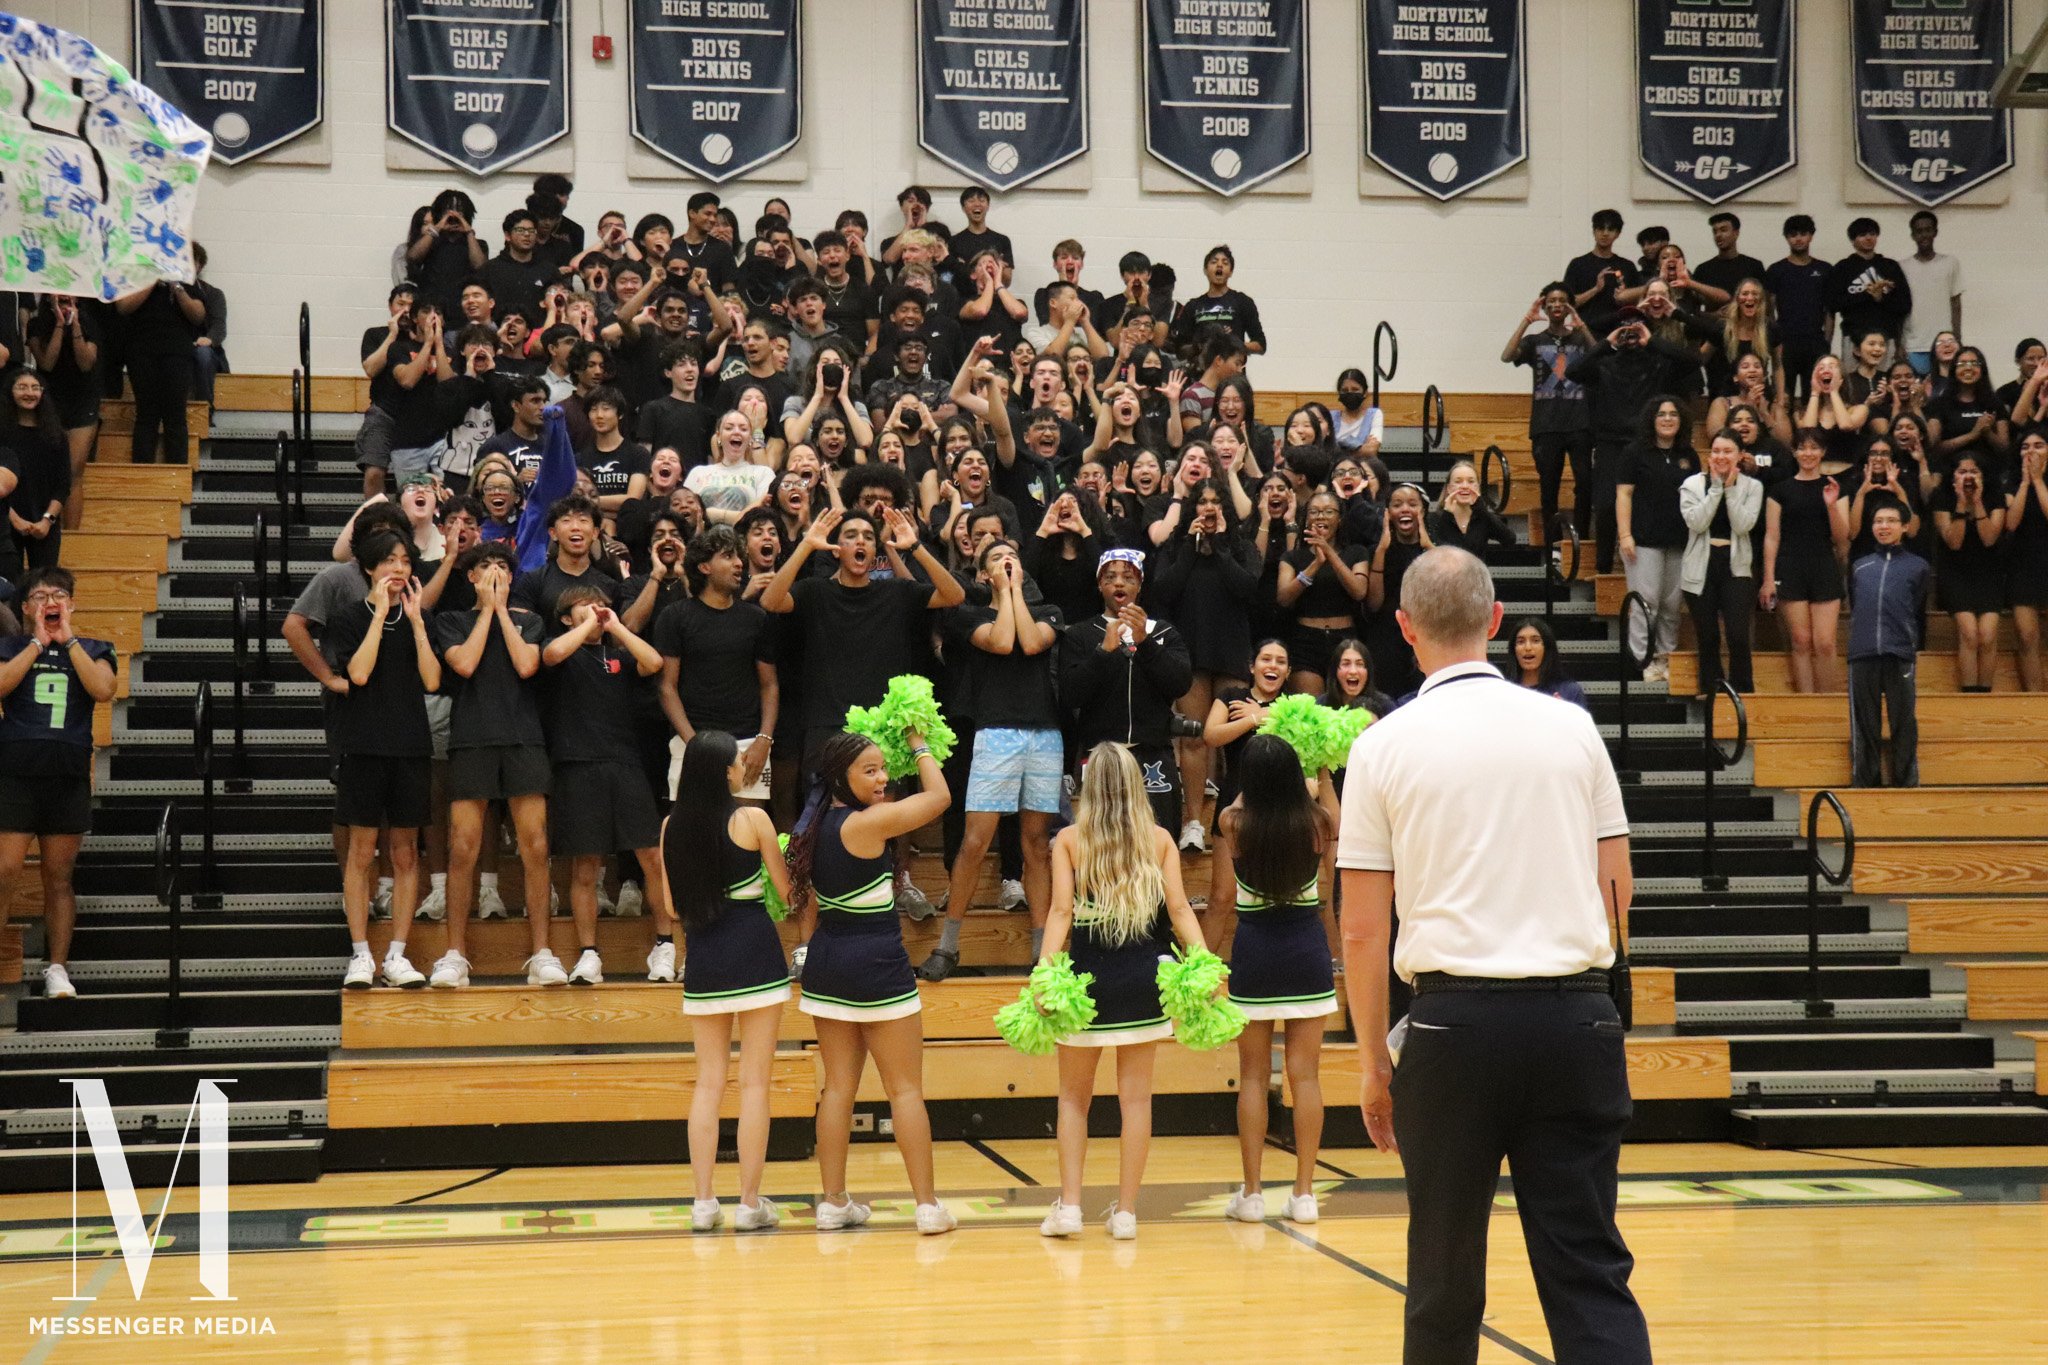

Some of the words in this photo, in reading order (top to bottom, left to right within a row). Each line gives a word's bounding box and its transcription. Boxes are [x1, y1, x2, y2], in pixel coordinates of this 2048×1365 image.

[662, 0, 701, 16] HIGH
[707, 2, 769, 19] SCHOOL
[955, 0, 1047, 10] NORTHVIEW
[1179, 0, 1270, 17] NORTHVIEW
[950, 11, 988, 27] HIGH
[994, 13, 1054, 30] SCHOOL
[1398, 6, 1487, 23] NORTHVIEW
[1670, 12, 1758, 28] NORTHVIEW
[1885, 15, 1973, 31] NORTHVIEW
[205, 15, 256, 35] BOYS
[1174, 18, 1212, 35] HIGH
[1217, 20, 1276, 36] SCHOOL
[1393, 24, 1429, 40] HIGH
[1435, 26, 1493, 42] SCHOOL
[204, 37, 257, 57] GOLF
[449, 29, 507, 48] GIRLS
[1665, 30, 1701, 46] HIGH
[1706, 32, 1763, 48] SCHOOL
[1880, 34, 1917, 49] HIGH
[1922, 34, 1978, 49] SCHOOL
[692, 39, 740, 58] BOYS
[453, 50, 504, 70] GOLF
[681, 57, 751, 79] TENNIS
[975, 50, 1029, 68] GIRLS
[1203, 56, 1248, 74] BOYS
[943, 69, 1061, 90] VOLLEYBALL
[1421, 62, 1466, 80] BOYS
[1689, 67, 1740, 85] GIRLS
[1904, 70, 1955, 87] GIRLS
[205, 80, 256, 101] 2007
[1193, 77, 1258, 95] TENNIS
[1411, 79, 1476, 101] TENNIS
[454, 92, 504, 112] 2007
[1645, 86, 1699, 104] CROSS
[1705, 88, 1783, 106] COUNTRY
[1861, 90, 1914, 107] CROSS
[1920, 91, 1992, 108] COUNTR
[693, 101, 740, 121] 2007
[979, 111, 1026, 130] 2008
[1203, 117, 1249, 136] 2008
[1421, 122, 1466, 140] 2009
[1693, 127, 1734, 145] 2013
[1910, 130, 1950, 148] 2014
[593, 473, 629, 484] LISTER
[34, 673, 69, 728] 9
